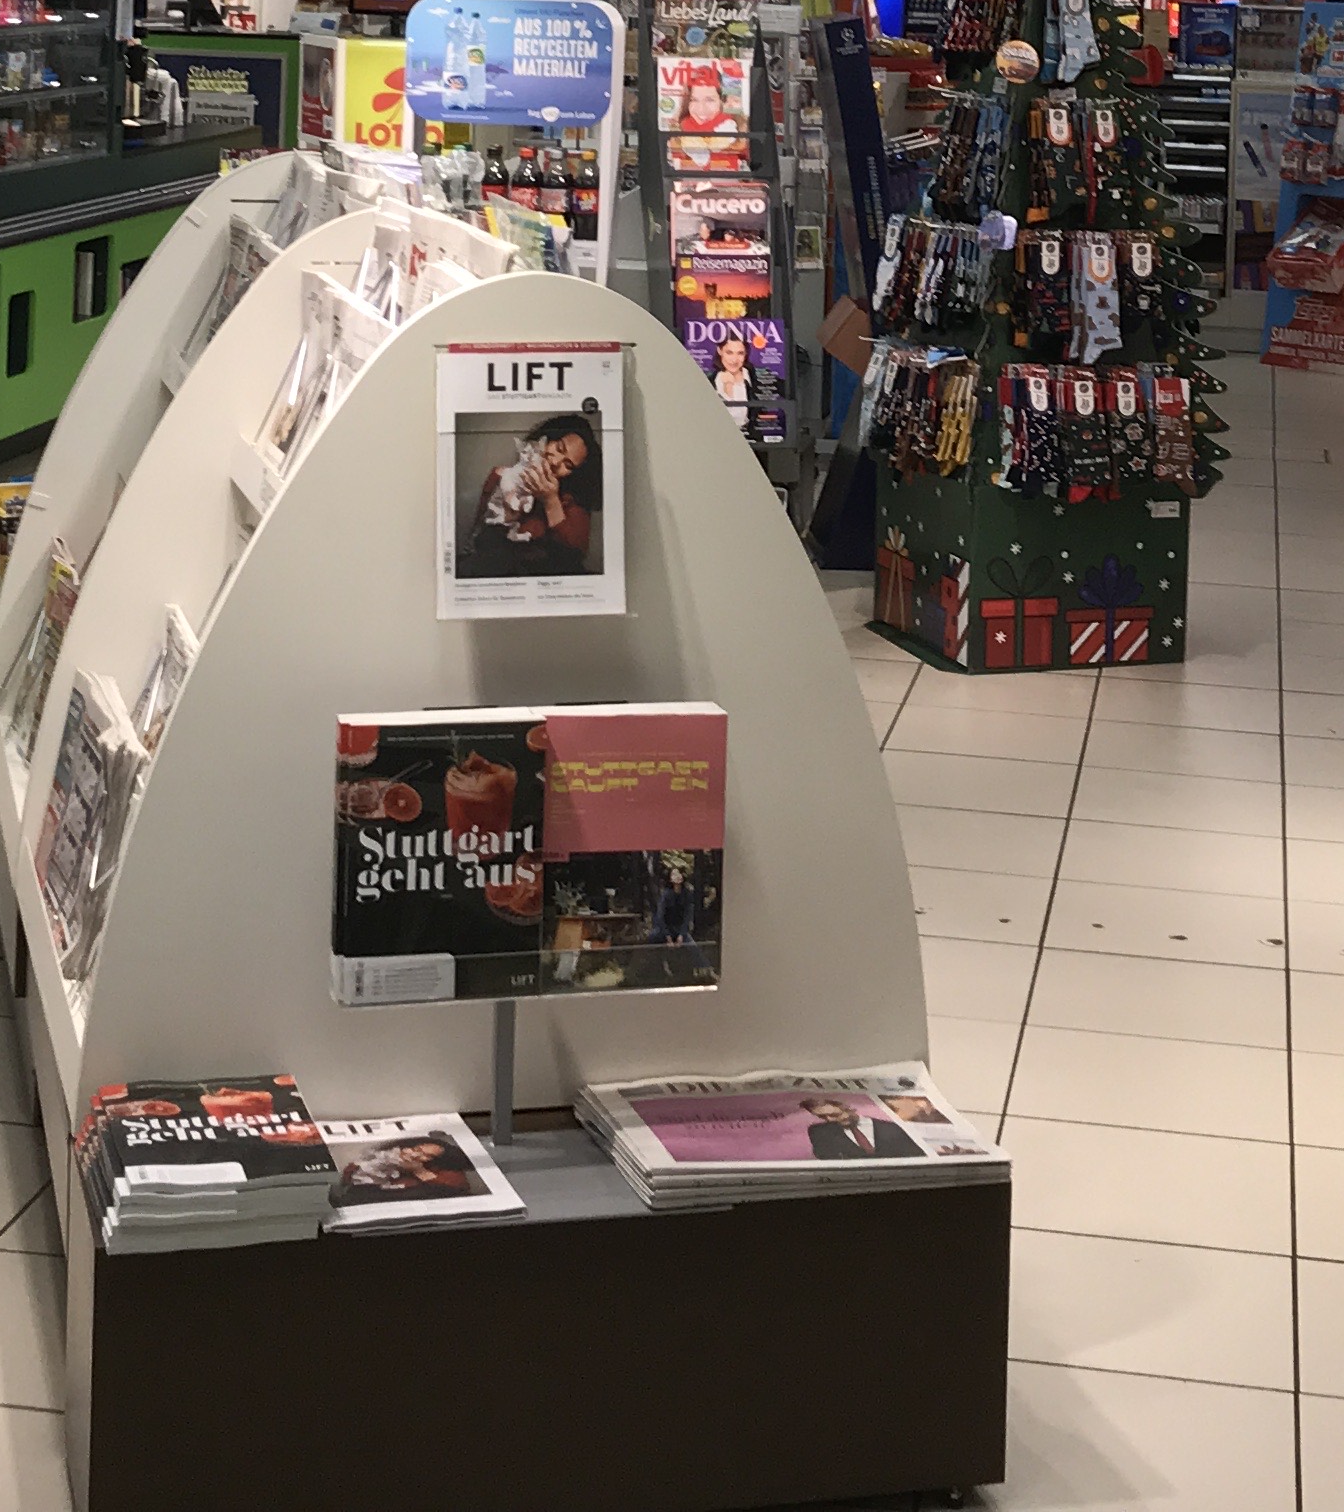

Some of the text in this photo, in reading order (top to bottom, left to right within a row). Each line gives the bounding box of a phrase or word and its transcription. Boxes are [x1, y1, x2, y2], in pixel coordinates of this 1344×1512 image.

[514, 16, 593, 39] AUS 100 %
[513, 37, 599, 60] RECYCELTEM
[660, 58, 718, 87] vital
[676, 193, 766, 215] Crucero
[692, 256, 768, 273] Reisemagazin
[687, 320, 784, 344] DONNA
[487, 361, 573, 392] LIFT
[358, 824, 535, 868] Stuttgart
[356, 857, 540, 903] geht aus
[319, 1118, 411, 1139] LIFT
